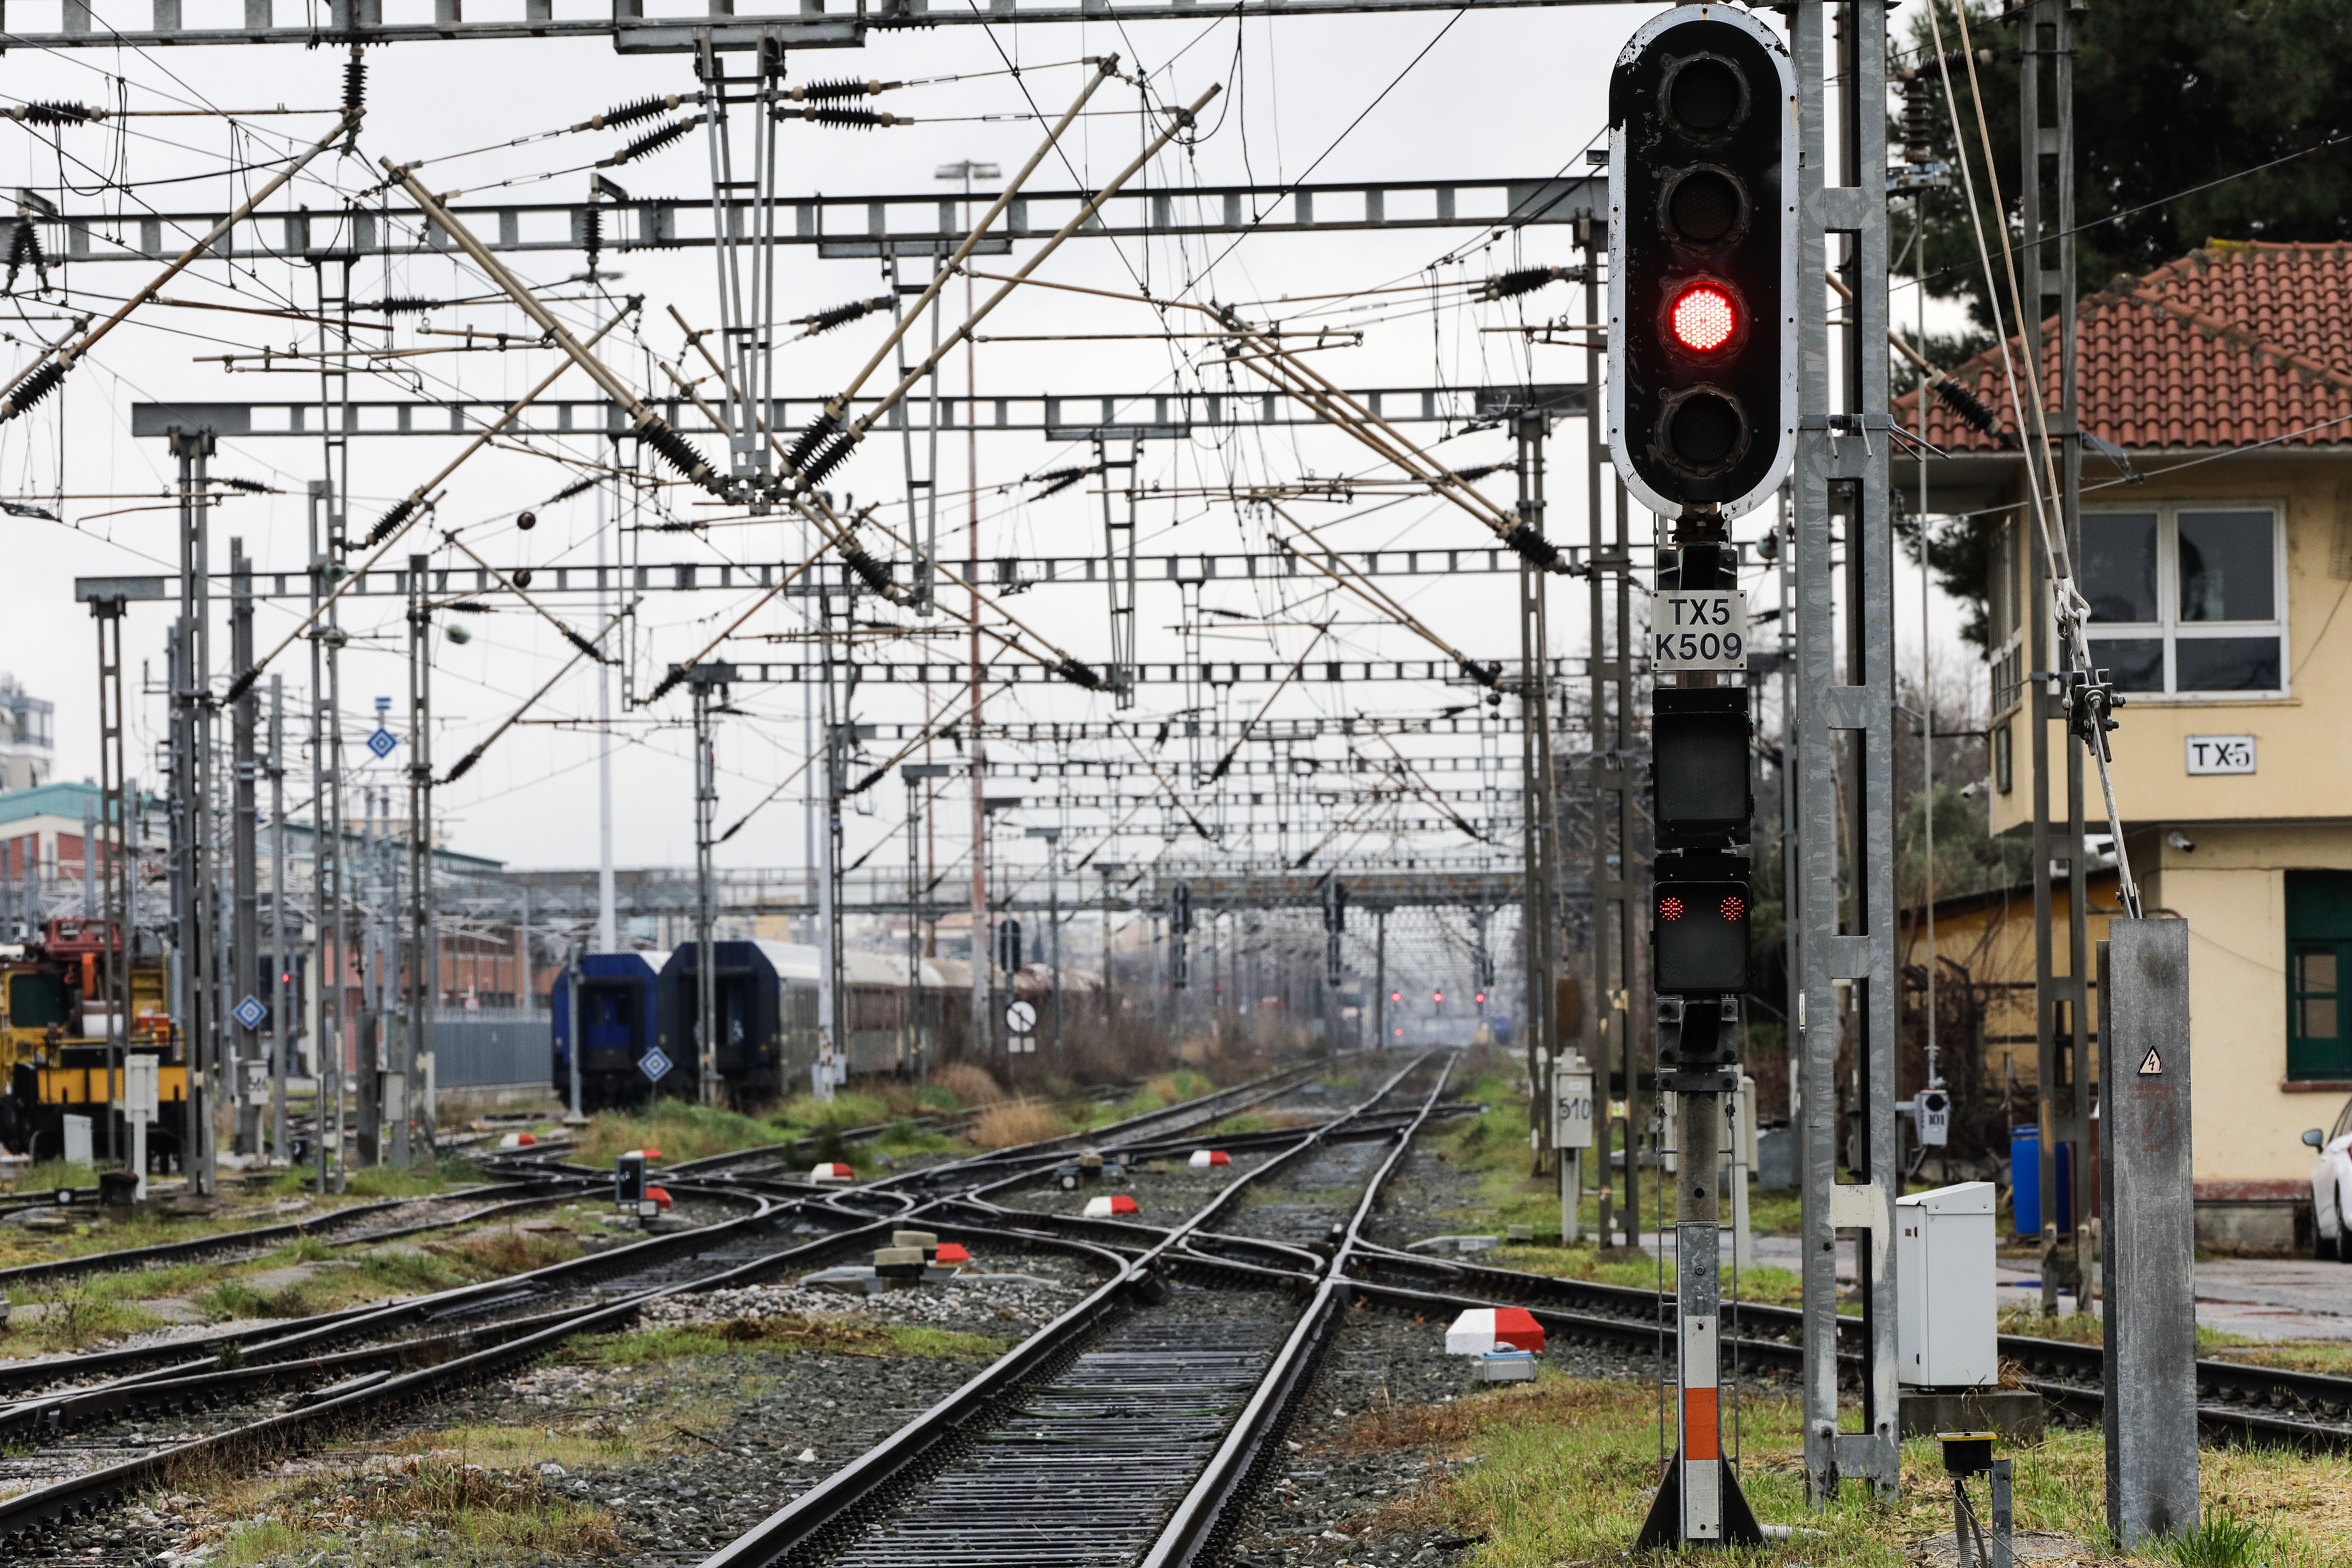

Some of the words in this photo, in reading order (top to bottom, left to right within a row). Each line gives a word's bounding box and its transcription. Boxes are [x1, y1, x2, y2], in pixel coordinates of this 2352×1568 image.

[1668, 599, 1730, 625] TX5
[1656, 632, 1742, 660] K509
[1558, 1098, 1592, 1120] 510
